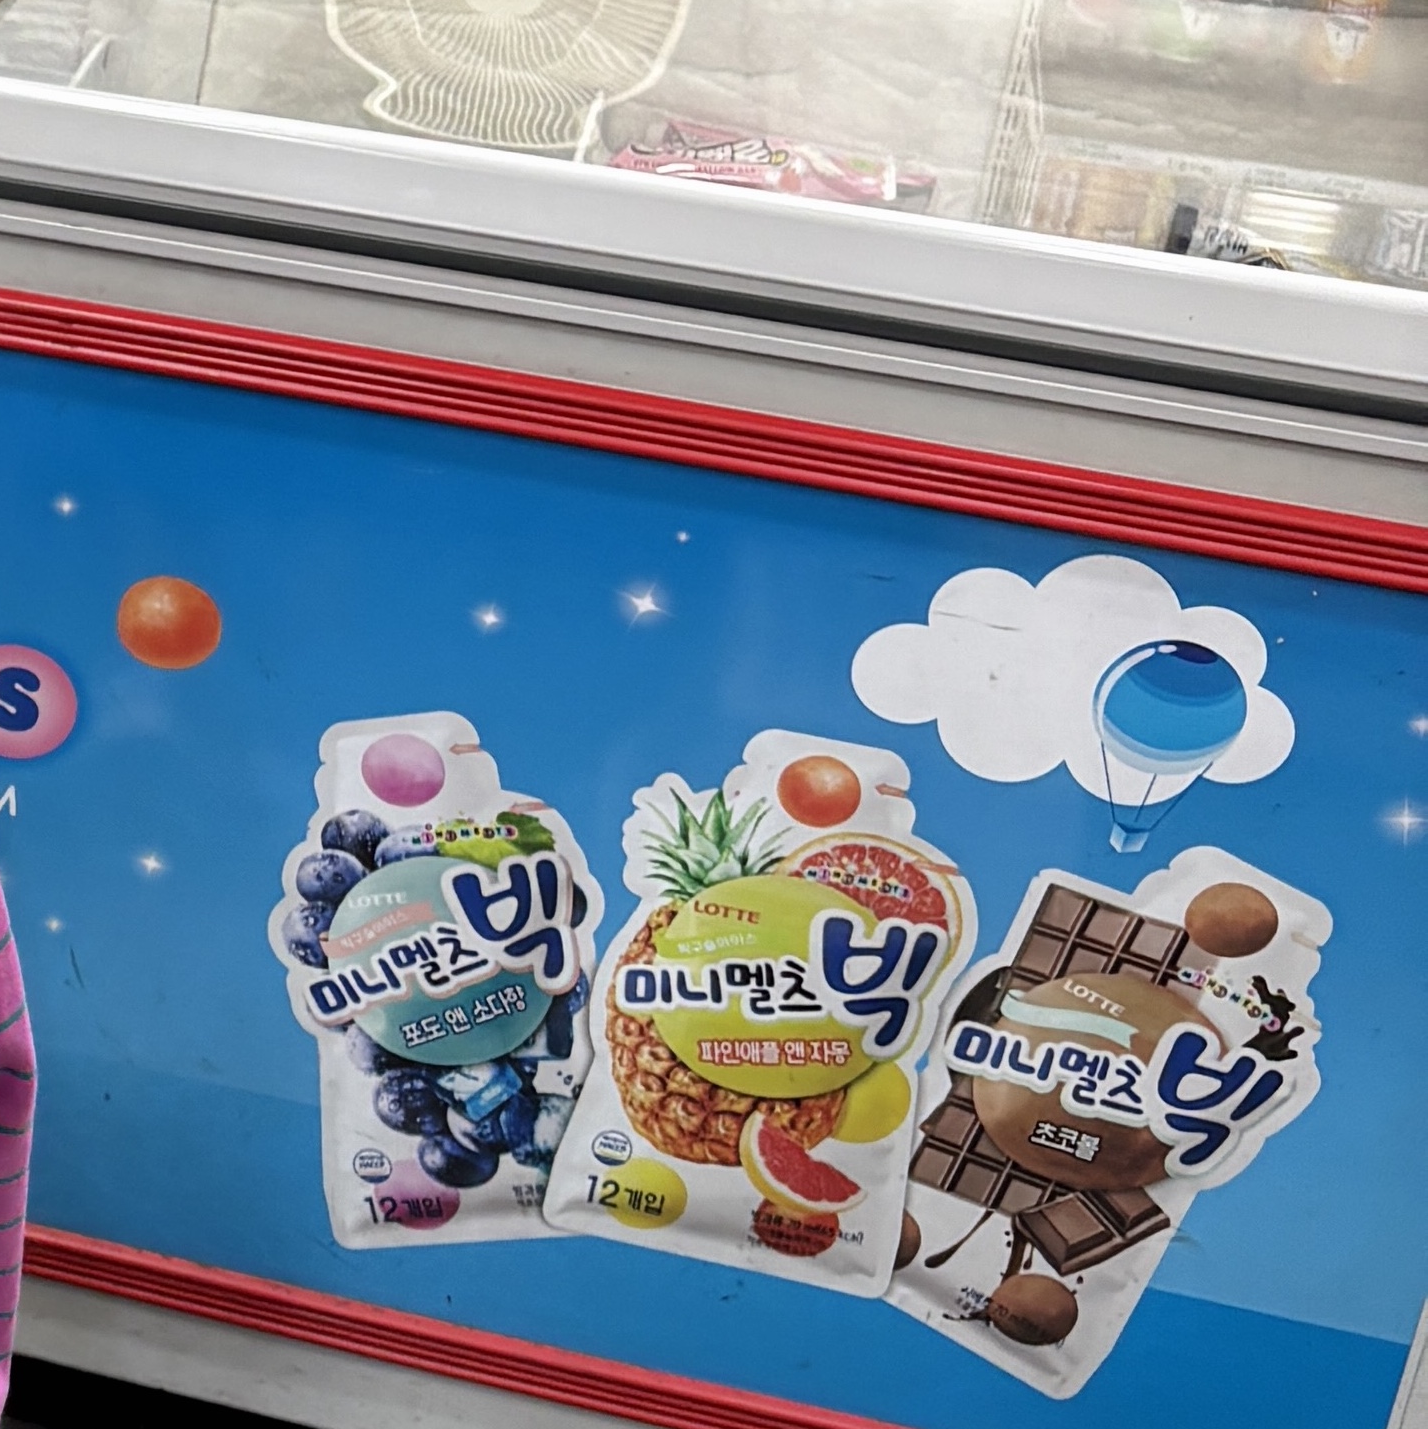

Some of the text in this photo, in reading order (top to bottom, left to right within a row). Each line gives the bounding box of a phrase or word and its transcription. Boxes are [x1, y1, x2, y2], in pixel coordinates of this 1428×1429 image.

[347, 891, 408, 909] LOTTE
[451, 858, 565, 980] 빅
[692, 899, 762, 925] LOTTE
[309, 925, 489, 1015] 미니멜츠
[624, 959, 824, 1015] 미니멜츠
[821, 916, 939, 1048] 빅
[402, 984, 526, 1049] 포도 앤 소다향
[1062, 978, 1126, 1018] LOTTE
[698, 1039, 852, 1067] 파인애플 앤 자몽
[952, 1027, 1145, 1116] 미니멜츠
[1156, 1030, 1285, 1167] 빅
[1030, 1121, 1102, 1163] 초코볼
[363, 1194, 445, 1225] 12개입
[586, 1174, 666, 1218] 12개입
